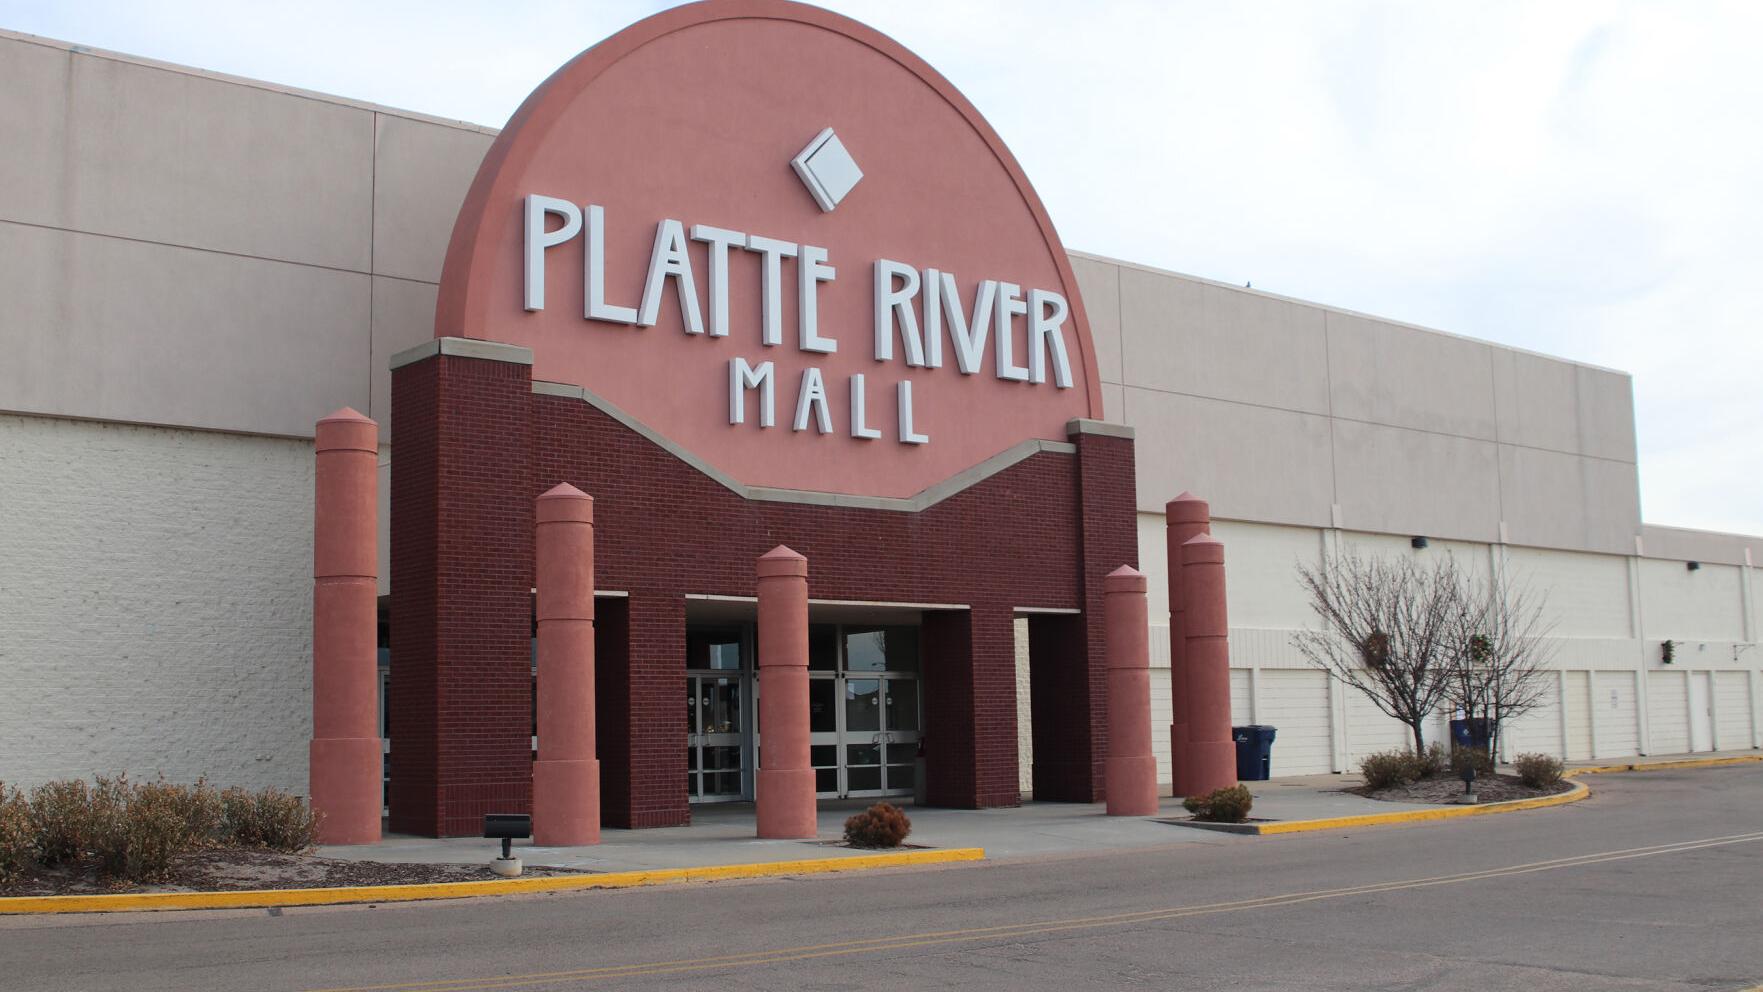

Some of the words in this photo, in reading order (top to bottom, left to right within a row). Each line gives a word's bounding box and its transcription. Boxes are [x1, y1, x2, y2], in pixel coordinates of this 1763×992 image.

[524, 194, 837, 353] PLATTE
[874, 259, 1074, 389] RIVER
[729, 357, 929, 444] MALL
